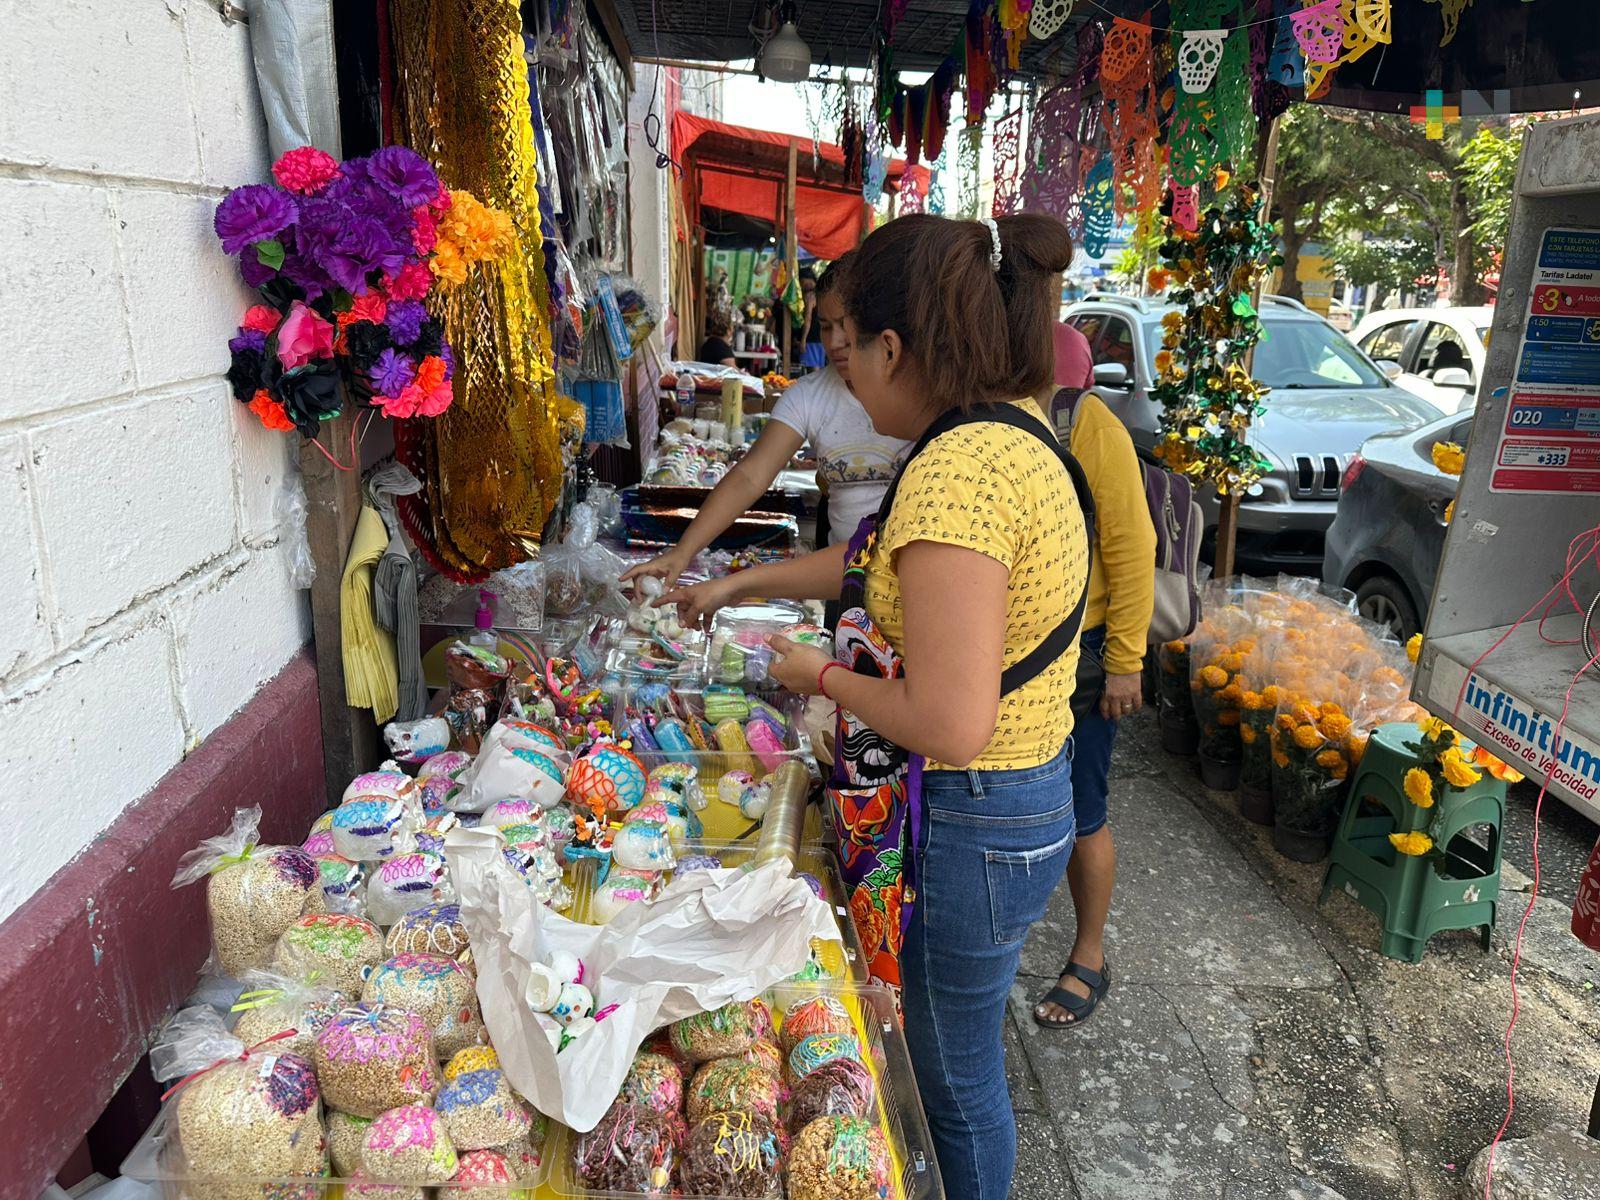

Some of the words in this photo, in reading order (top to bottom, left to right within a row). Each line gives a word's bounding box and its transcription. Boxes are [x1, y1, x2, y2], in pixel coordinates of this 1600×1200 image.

[1540, 270, 1564, 278] Tarifas
[1566, 272, 1593, 280] Ladatel
[1512, 410, 1543, 425] 020
[921, 471, 999, 489] FRIENDS
[915, 500, 994, 516] FRIENDS
[908, 529, 992, 544] FRIENDS
[1014, 547, 1073, 580] FRIENDS
[1011, 574, 1076, 608] FRIENDS
[1006, 600, 1077, 633] FRIENDS
[1465, 676, 1600, 784] infinitum
[1484, 720, 1521, 752] Exceso
[1522, 747, 1537, 762] de
[1538, 754, 1598, 801] Velocidad
